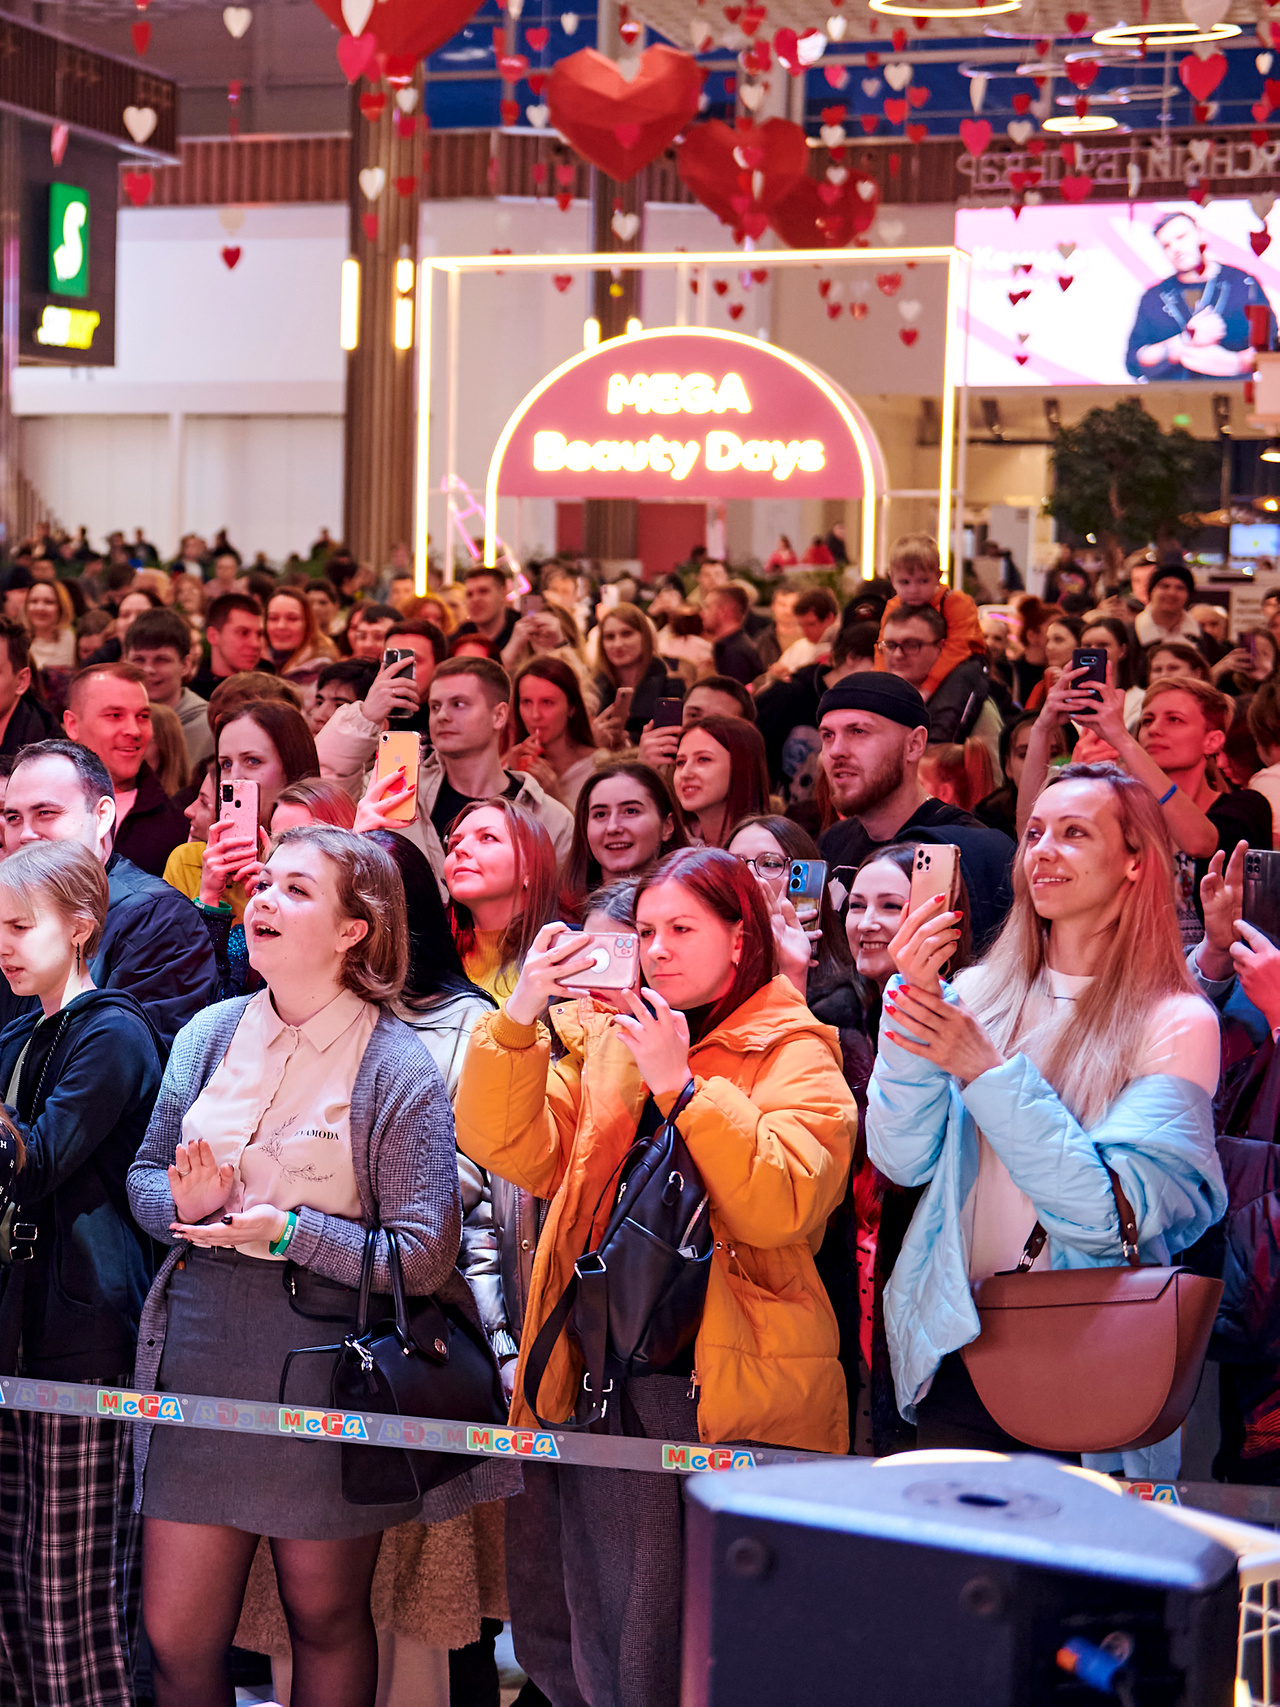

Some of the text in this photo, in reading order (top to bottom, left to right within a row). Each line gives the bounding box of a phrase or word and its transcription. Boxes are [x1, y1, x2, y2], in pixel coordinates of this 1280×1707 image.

[607, 372, 752, 415] MEGA
[533, 430, 826, 481] Beauty Days
